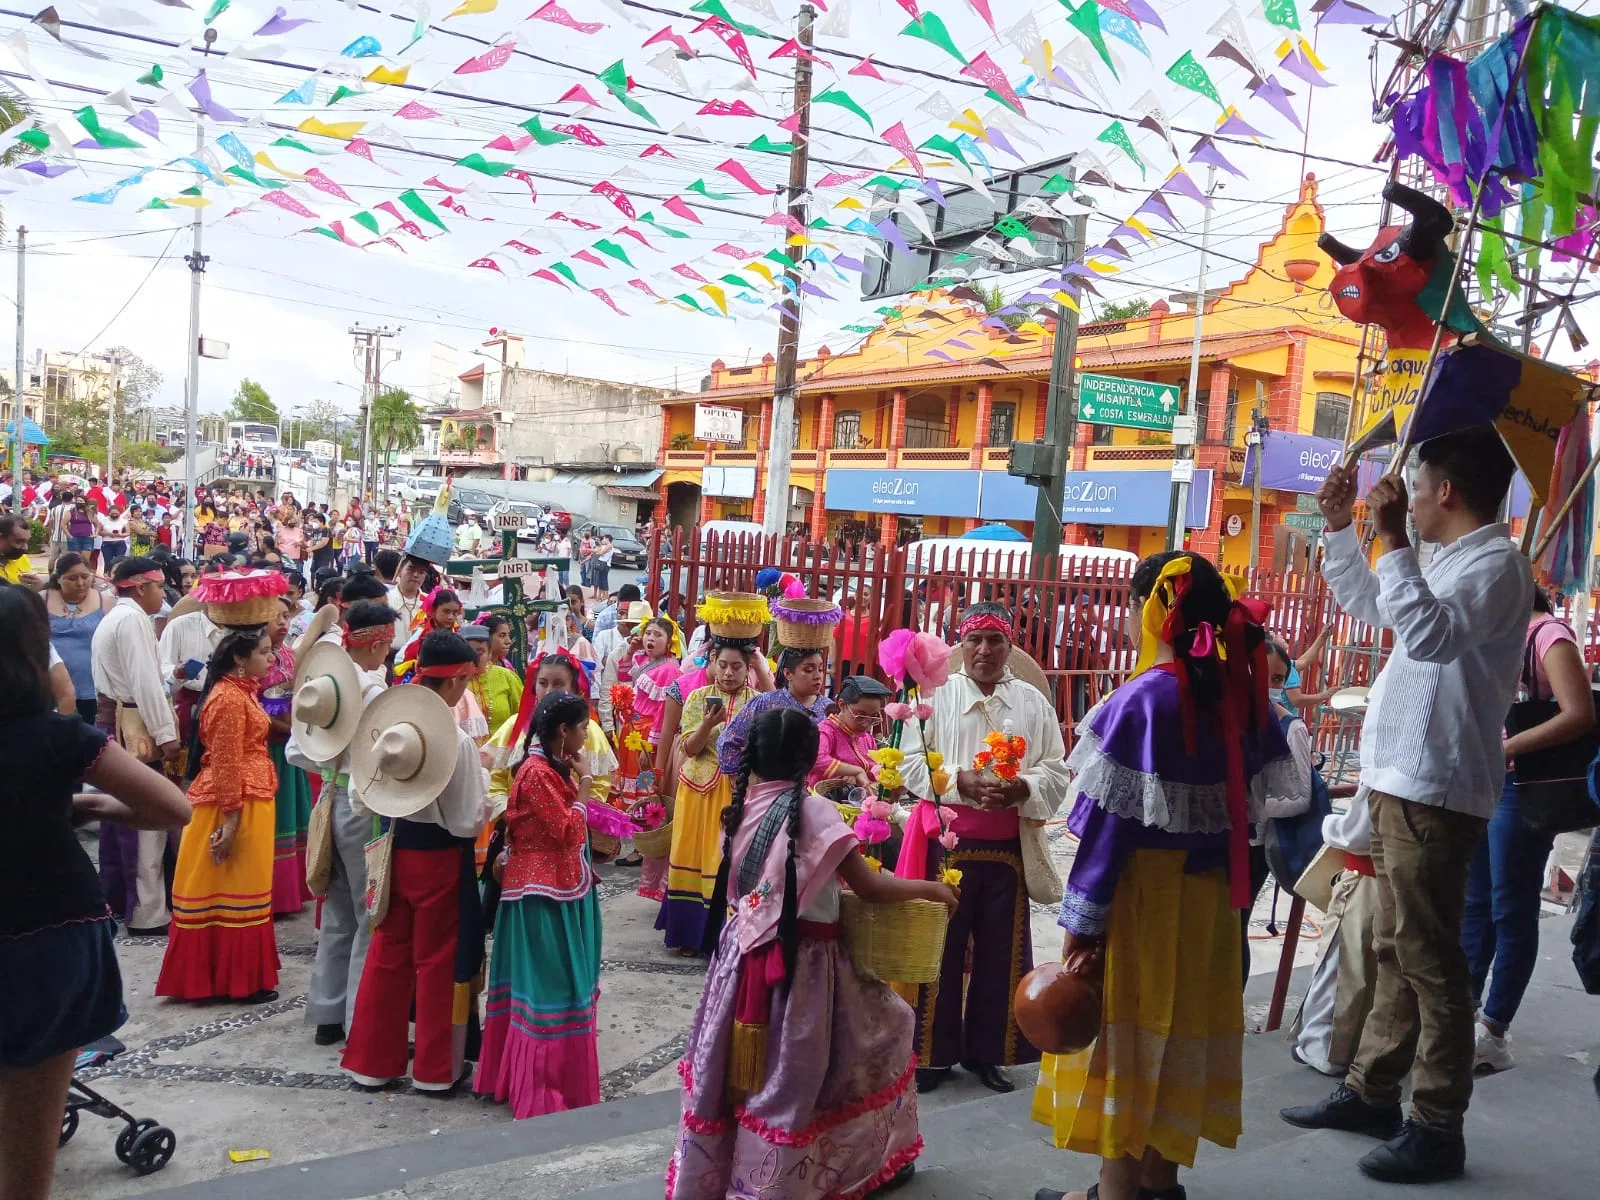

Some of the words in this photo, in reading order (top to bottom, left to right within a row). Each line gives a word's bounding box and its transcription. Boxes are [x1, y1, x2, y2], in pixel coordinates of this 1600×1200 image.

[1084, 378, 1156, 398] INDEPENDENCIA
[1096, 392, 1143, 408] MISANTLA
[703, 408, 737, 419] OPTICA
[1099, 407, 1124, 420] COSTA
[1127, 410, 1173, 425] ESMERALDA
[703, 431, 735, 440] DUARTE
[1299, 447, 1342, 471] elecZ
[872, 477, 919, 496] elecZion
[1063, 481, 1117, 502] ecZion
[498, 516, 524, 527] INRI
[503, 563, 528, 575] INRI
